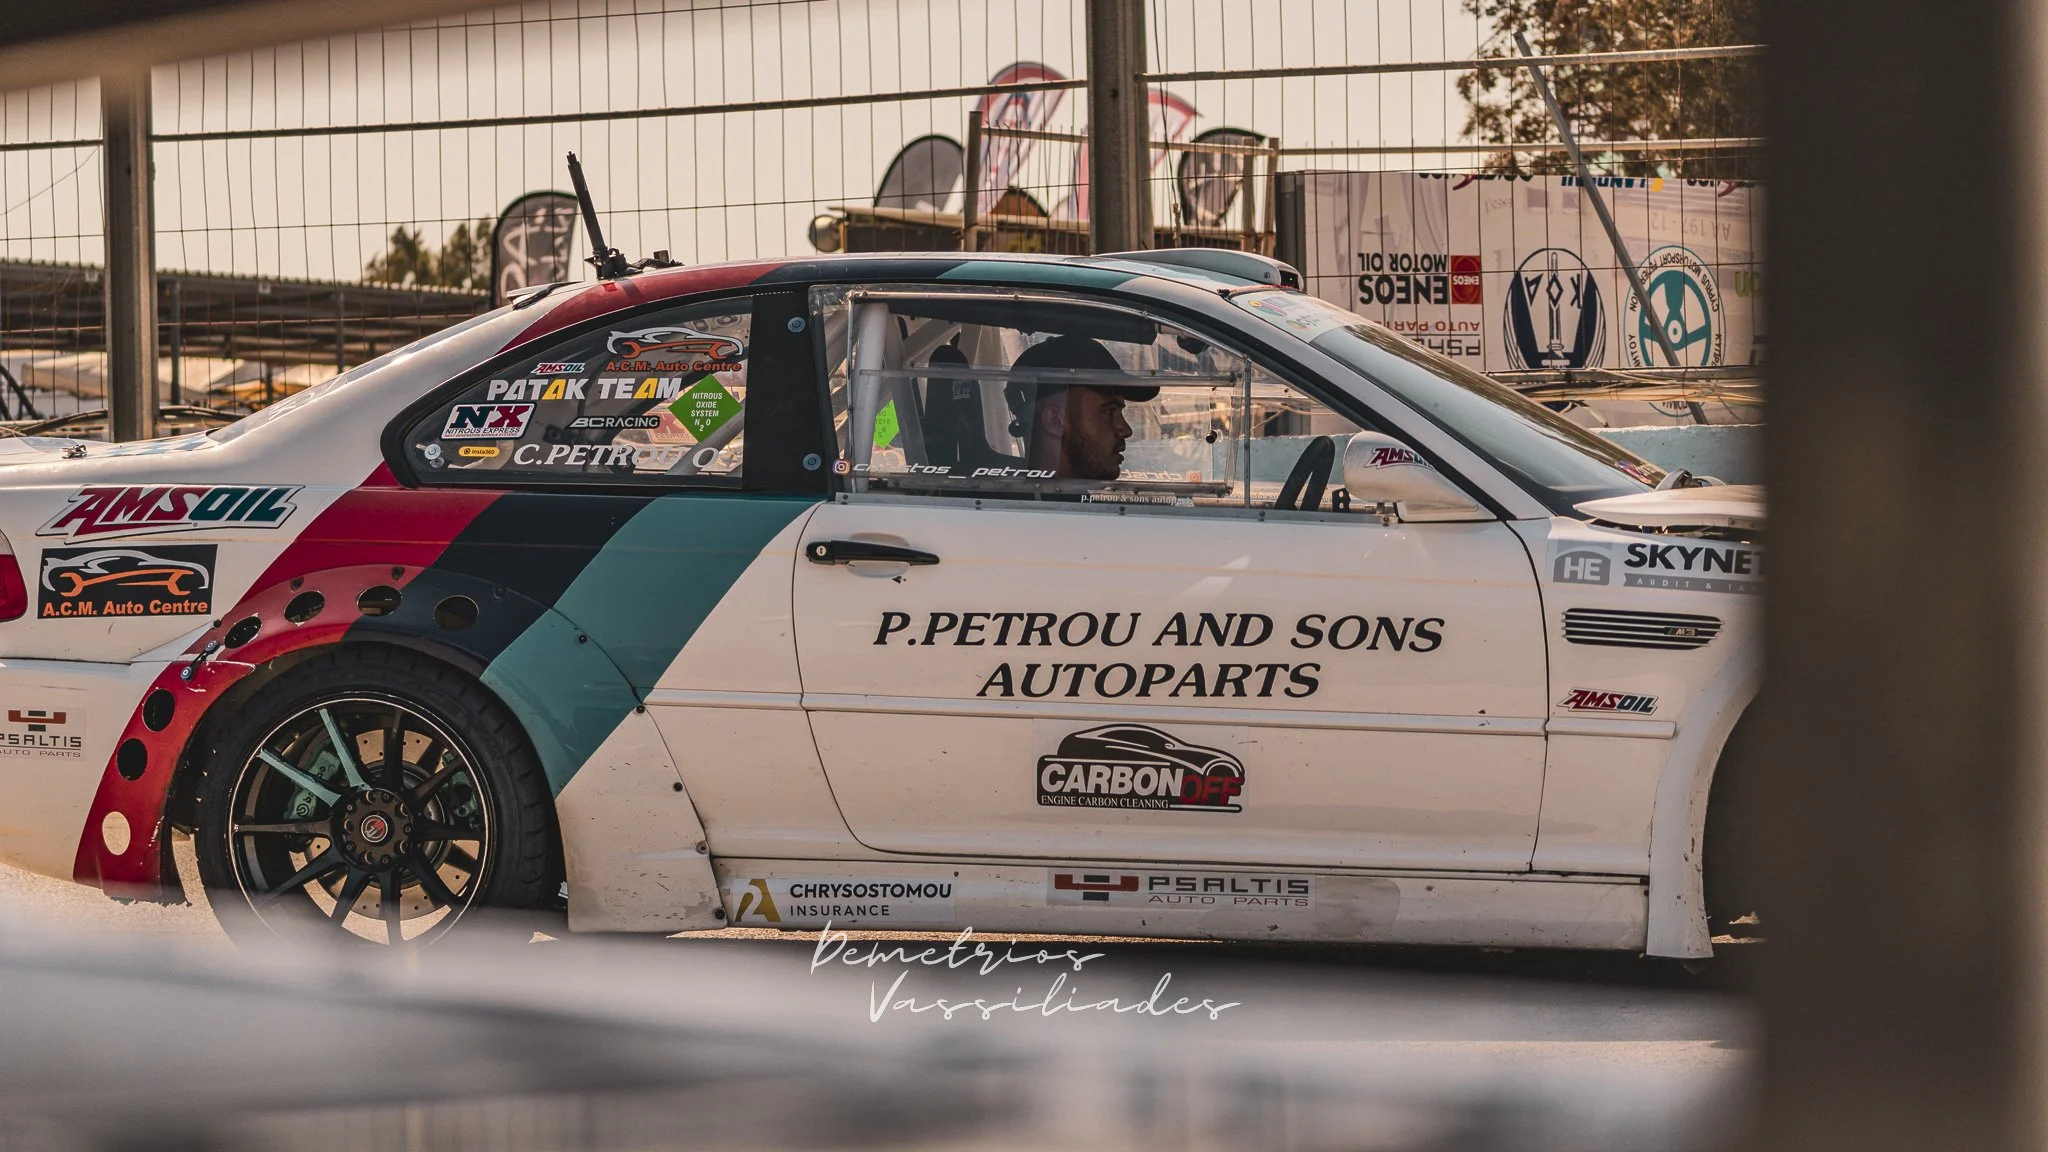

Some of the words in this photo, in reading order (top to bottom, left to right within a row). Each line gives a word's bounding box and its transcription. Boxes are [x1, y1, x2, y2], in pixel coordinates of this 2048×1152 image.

[1357, 252, 1383, 272] OIL
[1389, 253, 1447, 273] MOTOR
[1453, 275, 1480, 285] ENEOS
[1358, 274, 1448, 304] ENEOS
[1374, 320, 1429, 332] PART
[1435, 321, 1480, 332] AUTO
[532, 362, 585, 375] AMSOIL
[604, 361, 651, 372] A.C.M.
[655, 361, 689, 371] Auto
[691, 361, 742, 372] Centre
[486, 378, 589, 401] PATAK
[597, 377, 683, 399] TEAM
[450, 405, 531, 428] NX
[482, 426, 520, 434] EXPRESS
[46, 486, 297, 537] AMSOIL
[1563, 556, 1602, 581] HE
[1637, 578, 1690, 588] AUDIT
[1705, 582, 1712, 591] &
[43, 601, 98, 616] A.C.M.
[103, 601, 144, 615] Auto
[149, 599, 208, 614] Centre
[873, 611, 1141, 647] P.PETROU
[1152, 611, 1273, 648] AND
[1290, 614, 1446, 652] SONS
[976, 662, 1321, 699] AUTOPARTS
[1562, 688, 1656, 713] AMSOIL
[39, 750, 81, 758] PARTS
[1041, 795, 1077, 805] ENGINE
[1078, 796, 1118, 807] CARBON
[1121, 798, 1169, 809] CLEANING
[789, 883, 952, 899] CHRYSOSTOMOU
[1149, 876, 1309, 894] PSALTIS
[1149, 895, 1216, 904] AUTO
[1233, 896, 1309, 907] PARTS
[789, 904, 890, 917] INSURANCE
